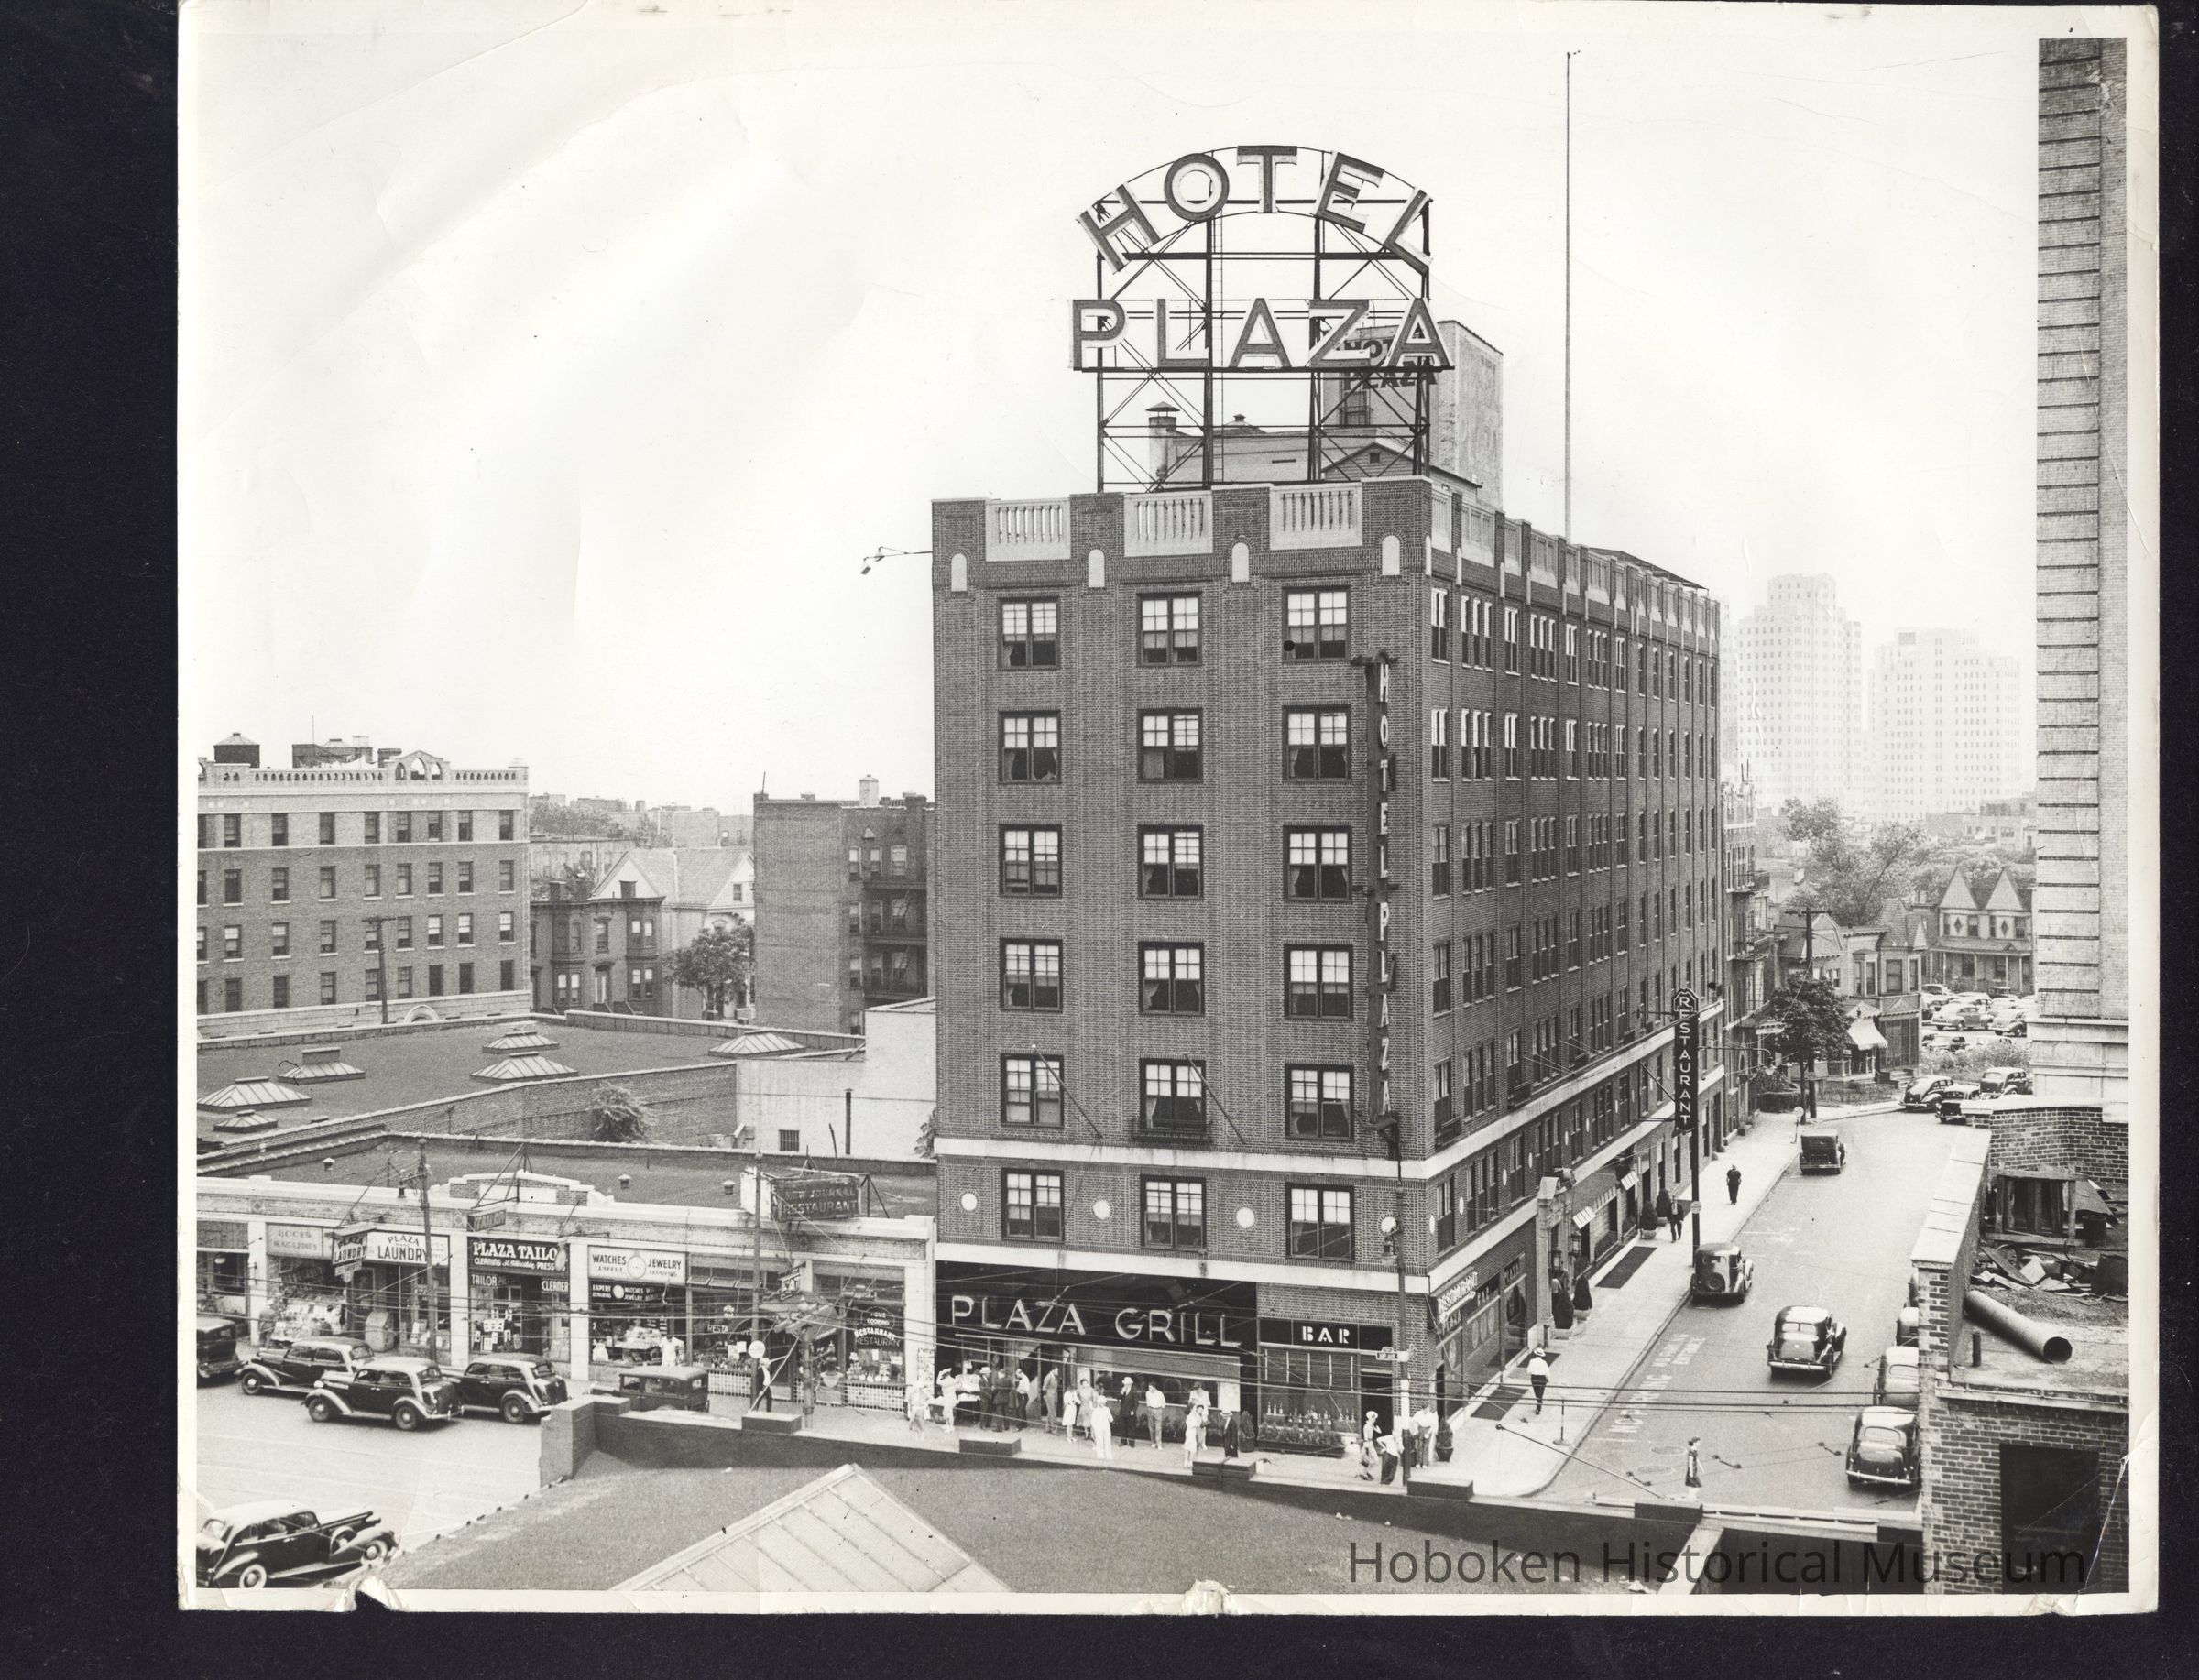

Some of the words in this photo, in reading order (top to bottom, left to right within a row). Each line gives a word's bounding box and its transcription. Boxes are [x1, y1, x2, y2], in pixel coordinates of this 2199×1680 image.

[1076, 146, 1434, 275] HOTEL
[1068, 298, 1451, 369] PLAZA
[1379, 662, 1390, 879] HOTEL
[1380, 901, 1392, 1117] PLAZA
[1679, 995, 1692, 1126] RESTAURANT
[782, 1199, 859, 1215] RESTAURANT
[388, 1235, 421, 1248] PLAZA
[377, 1244, 428, 1263] LAUNDRY
[473, 1241, 517, 1259] PLAZA
[518, 1245, 568, 1263] TAILO
[592, 1253, 627, 1266] WATCHES
[474, 1258, 501, 1267] CLEANING
[647, 1258, 682, 1271] JEWELRY
[471, 1274, 498, 1287] TAILOR
[541, 1280, 569, 1293] CLEANER
[950, 1294, 1087, 1336] PLAZA
[1114, 1306, 1242, 1347] GRILL
[854, 1326, 897, 1342] RESTAURANT
[1301, 1325, 1351, 1345] BAR
